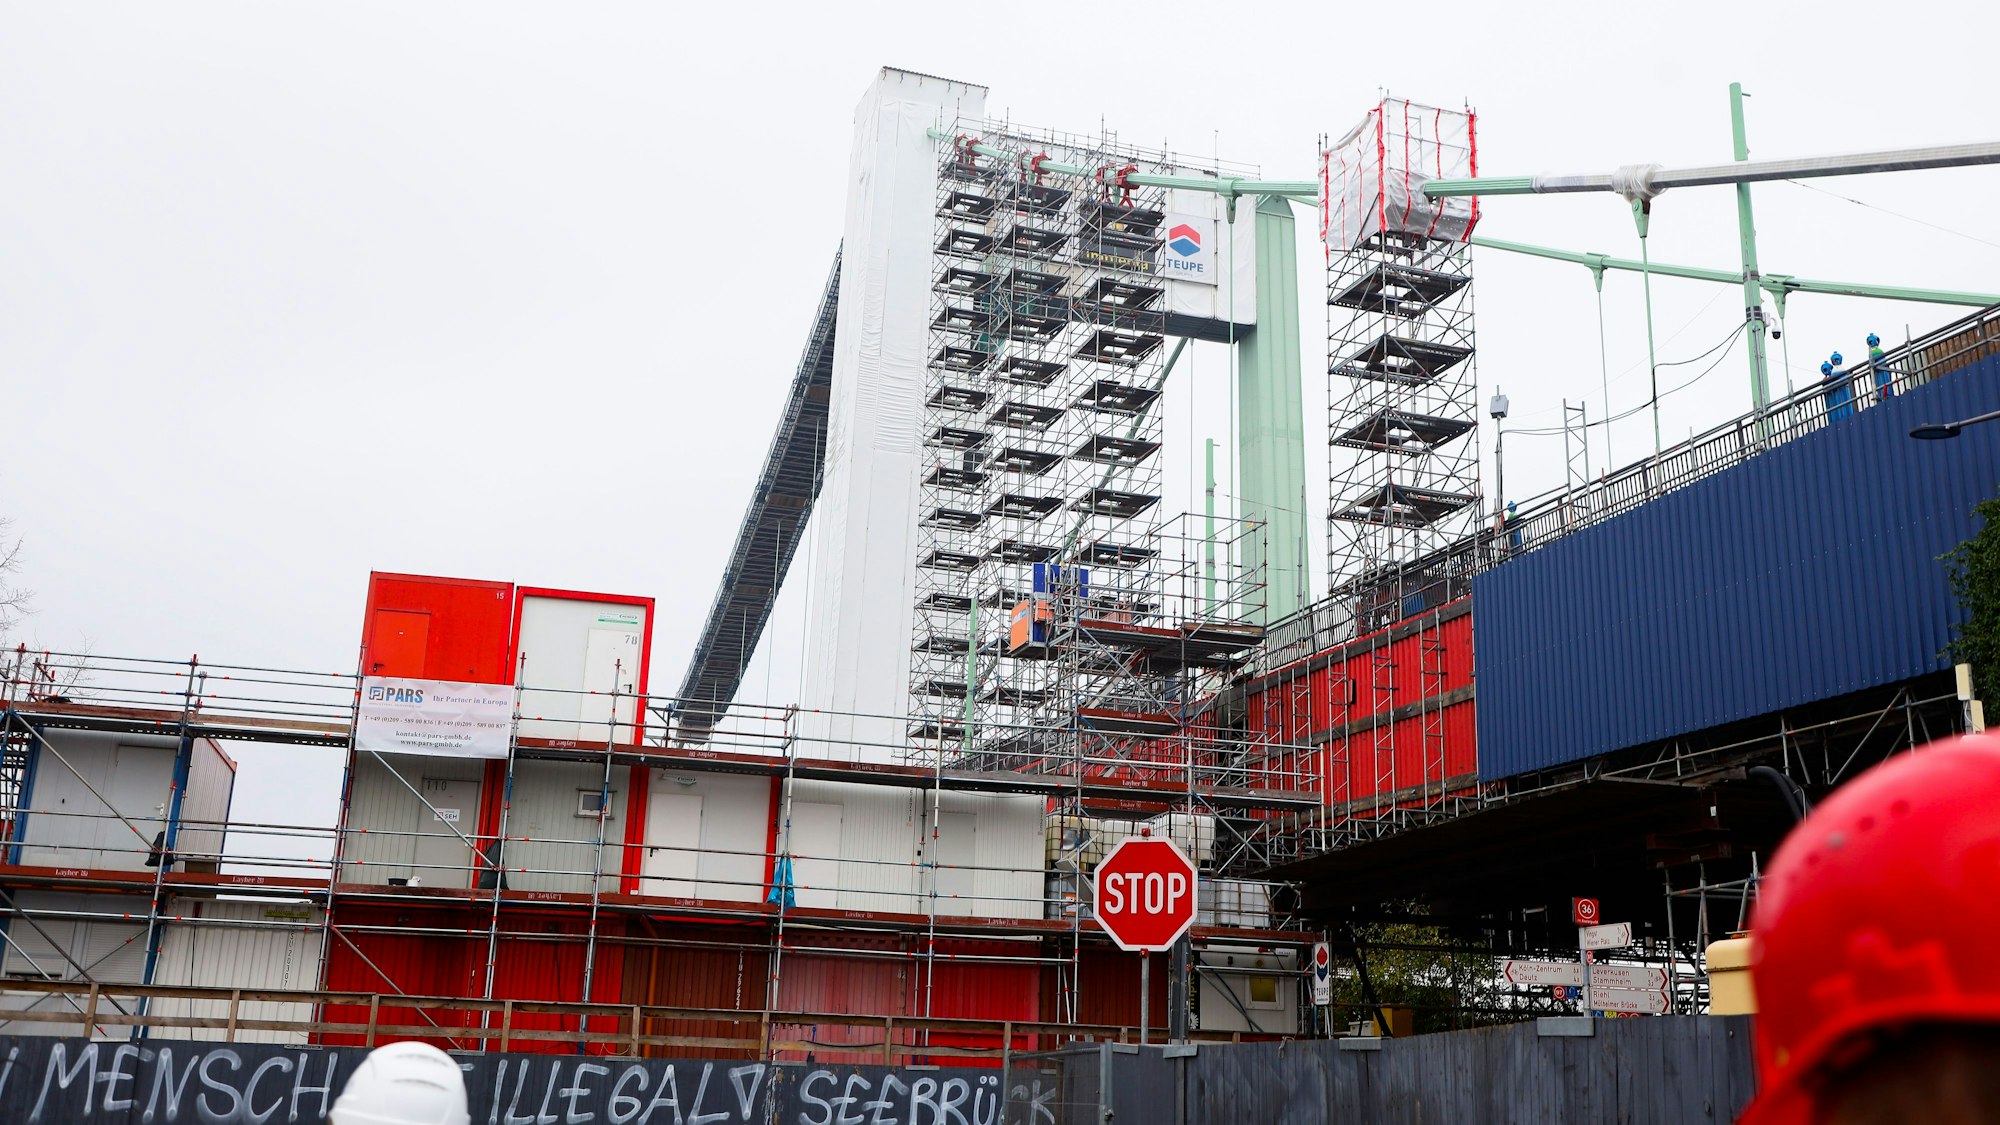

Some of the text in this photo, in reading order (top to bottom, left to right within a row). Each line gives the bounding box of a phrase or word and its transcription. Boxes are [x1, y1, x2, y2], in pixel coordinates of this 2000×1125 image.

[1166, 258, 1204, 273] TEUPE
[625, 634, 637, 645] 78
[385, 687, 424, 704] PARS
[446, 695, 472, 703] Partner
[482, 697, 508, 706] Europa
[395, 730, 472, 741] kontakt@pars-gmbh.de
[400, 739, 463, 748] www.pars-gmbh.de
[427, 780, 447, 791] 110
[1122, 779, 1142, 787] Layher
[55, 868, 79, 877] Layher
[232, 876, 256, 884] Layher
[1105, 872, 1186, 914] STOP
[1581, 903, 1593, 914] 36
[1519, 964, 1563, 974] Köln-Zentrum
[1592, 968, 1630, 977] Leverkusen
[1520, 973, 1538, 981] Deutz
[1592, 976, 1632, 985] Stammheim
[1316, 986, 1329, 996] TEUPE
[1593, 990, 1610, 999] Riehl
[1593, 1000, 1638, 1009] Mülheimer Brücke
[29, 1042, 338, 1122] MENSCH
[489, 1059, 730, 1125] ILLEGAL
